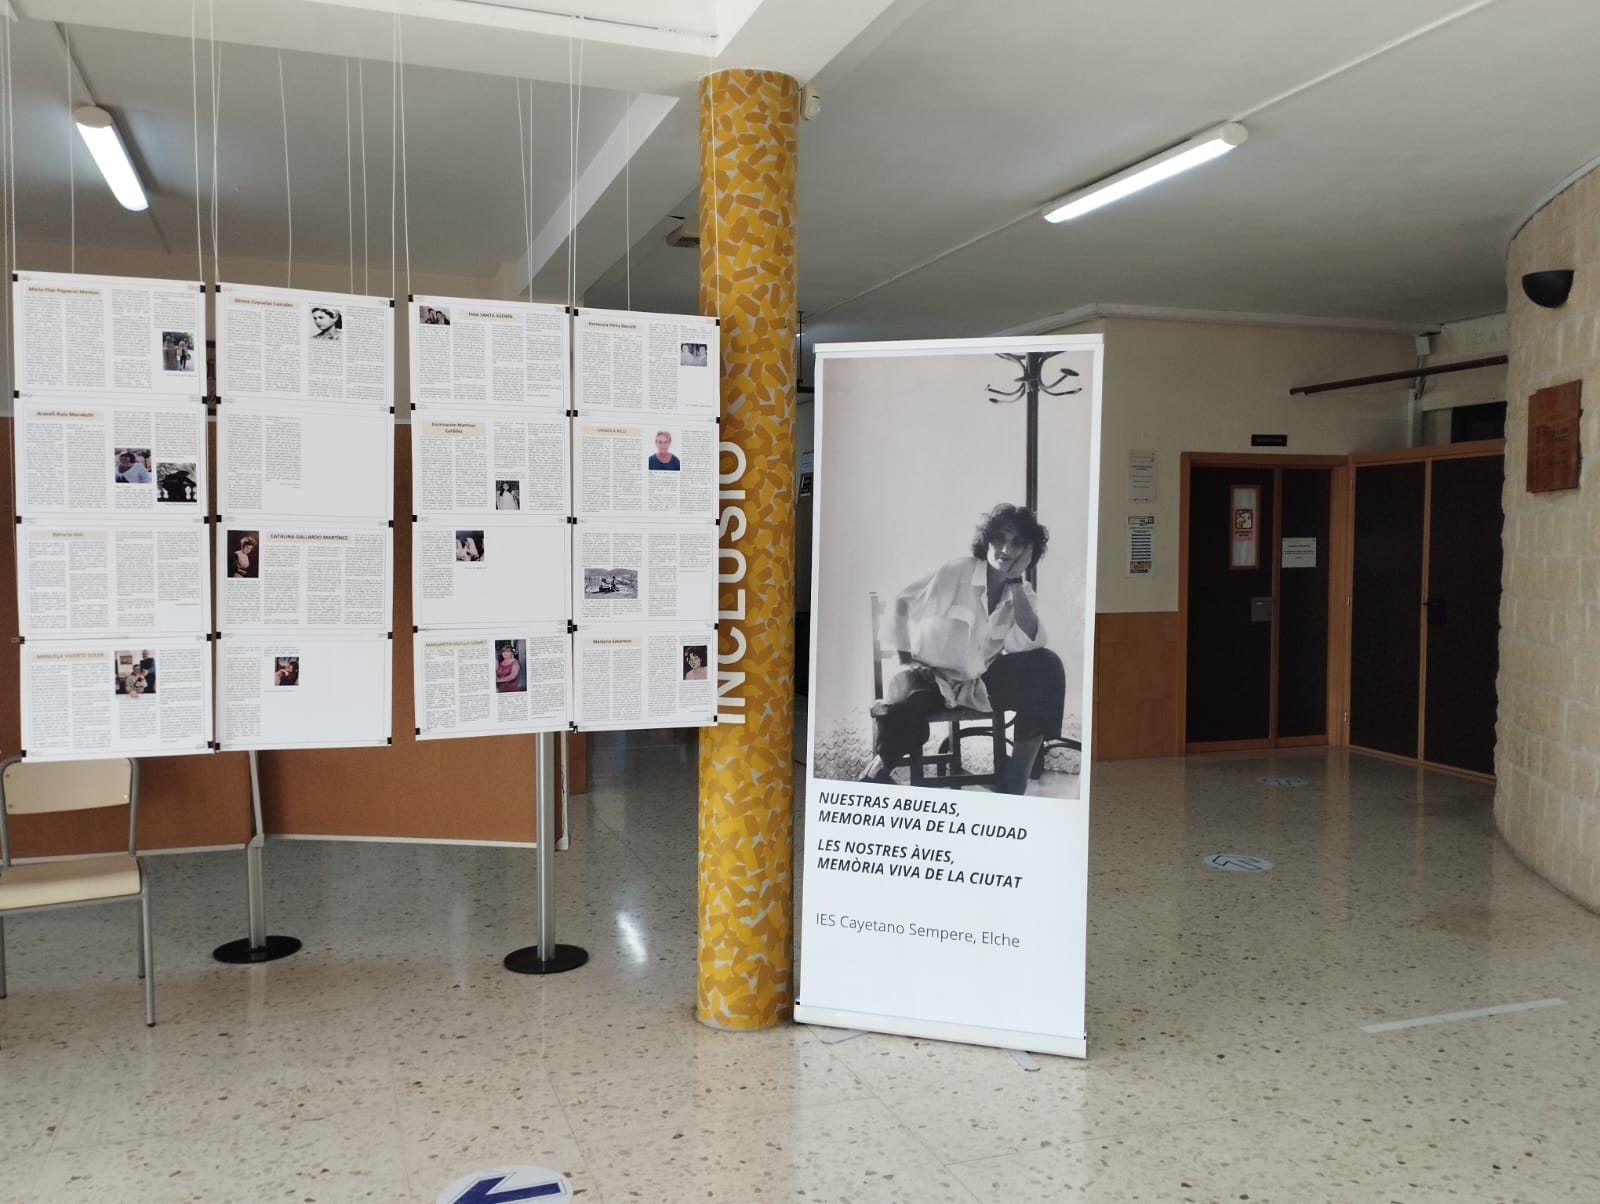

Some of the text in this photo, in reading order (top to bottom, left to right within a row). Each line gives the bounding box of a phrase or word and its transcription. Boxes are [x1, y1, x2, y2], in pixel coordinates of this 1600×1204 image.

[818, 791, 960, 817] NUESTRAS ABUELAS,
[818, 810, 1027, 840] MEMORIA VIVA DE LA CIUDAD
[818, 839, 955, 865] LES NOSTRES ÀVIES,
[817, 857, 1023, 889] MEMÒRIA VIVA DE LA CIUTAT
[816, 912, 1021, 948] IES Cayetano Sempere, Elche
